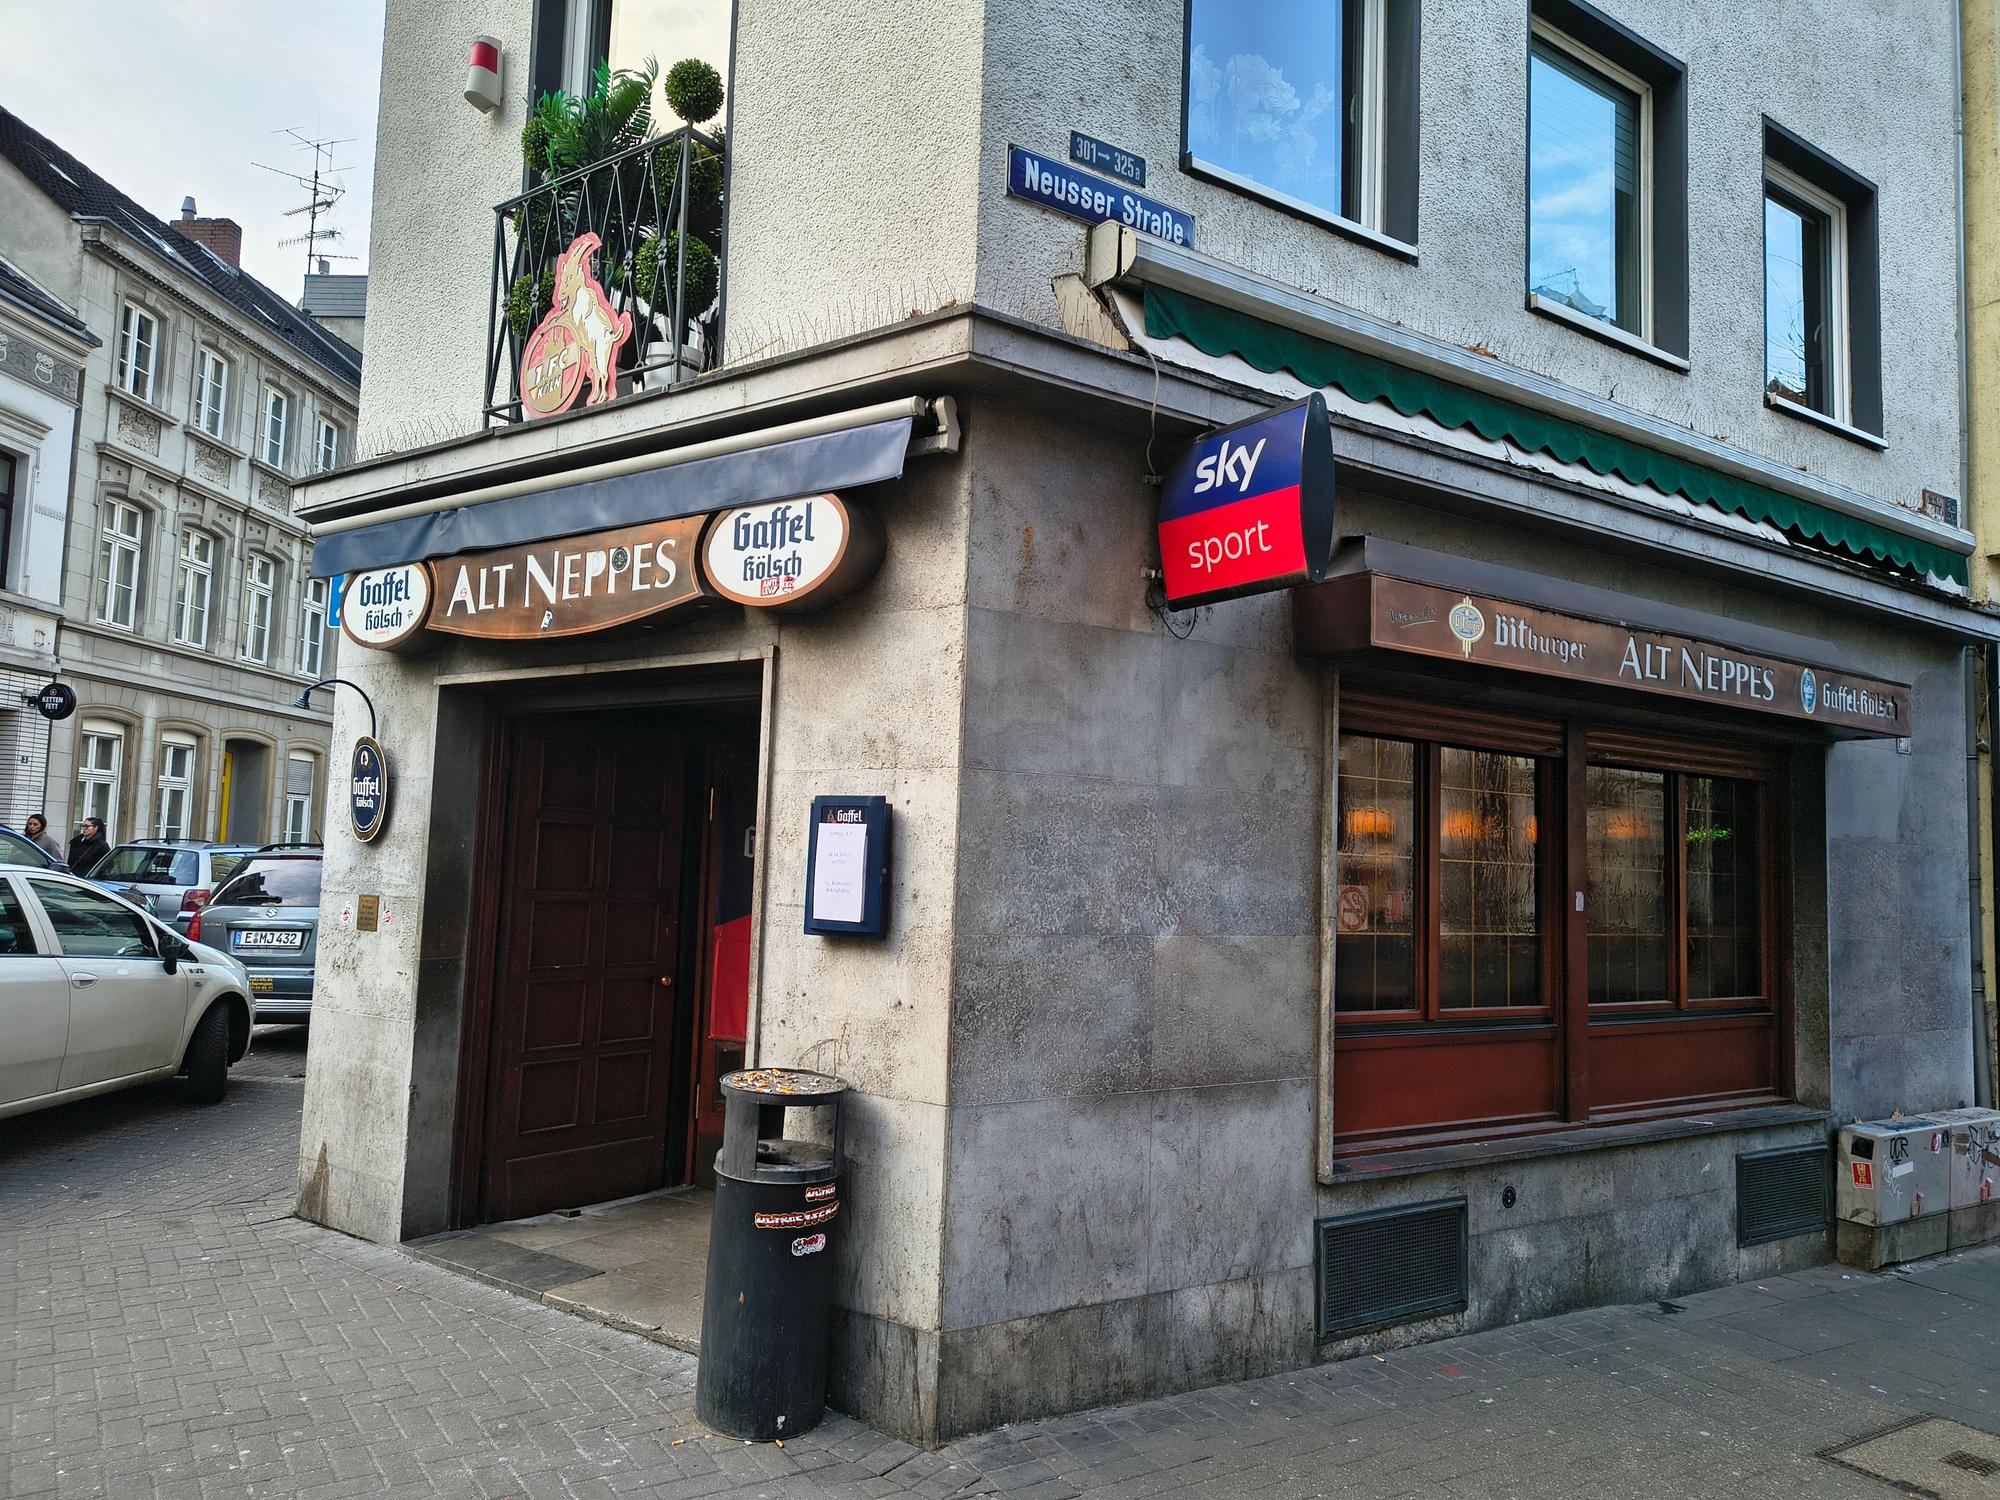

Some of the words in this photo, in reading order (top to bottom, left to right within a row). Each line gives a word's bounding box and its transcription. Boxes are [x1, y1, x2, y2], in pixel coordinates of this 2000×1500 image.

[1076, 136, 1098, 164] 301
[1114, 151, 1141, 179] 325a
[1025, 157, 1115, 217] Neusser
[1122, 194, 1184, 245] Straße
[547, 348, 567, 377] FC
[1194, 438, 1267, 494] sky
[733, 501, 815, 551] Gaffel
[1188, 520, 1272, 573] sport
[446, 563, 514, 617] ALT
[524, 538, 677, 608] NEPPES
[743, 550, 801, 581] Kölsch
[360, 569, 411, 607] Gaffel
[365, 606, 402, 631] Kölsch
[1494, 613, 1588, 663] Bitburger
[1618, 635, 1671, 680] ALT
[1681, 646, 1775, 701] NEPPES
[353, 776, 381, 797] Gaffel
[837, 809, 862, 823] Gaffel
[244, 932, 253, 944] E
[276, 933, 297, 945] 432
